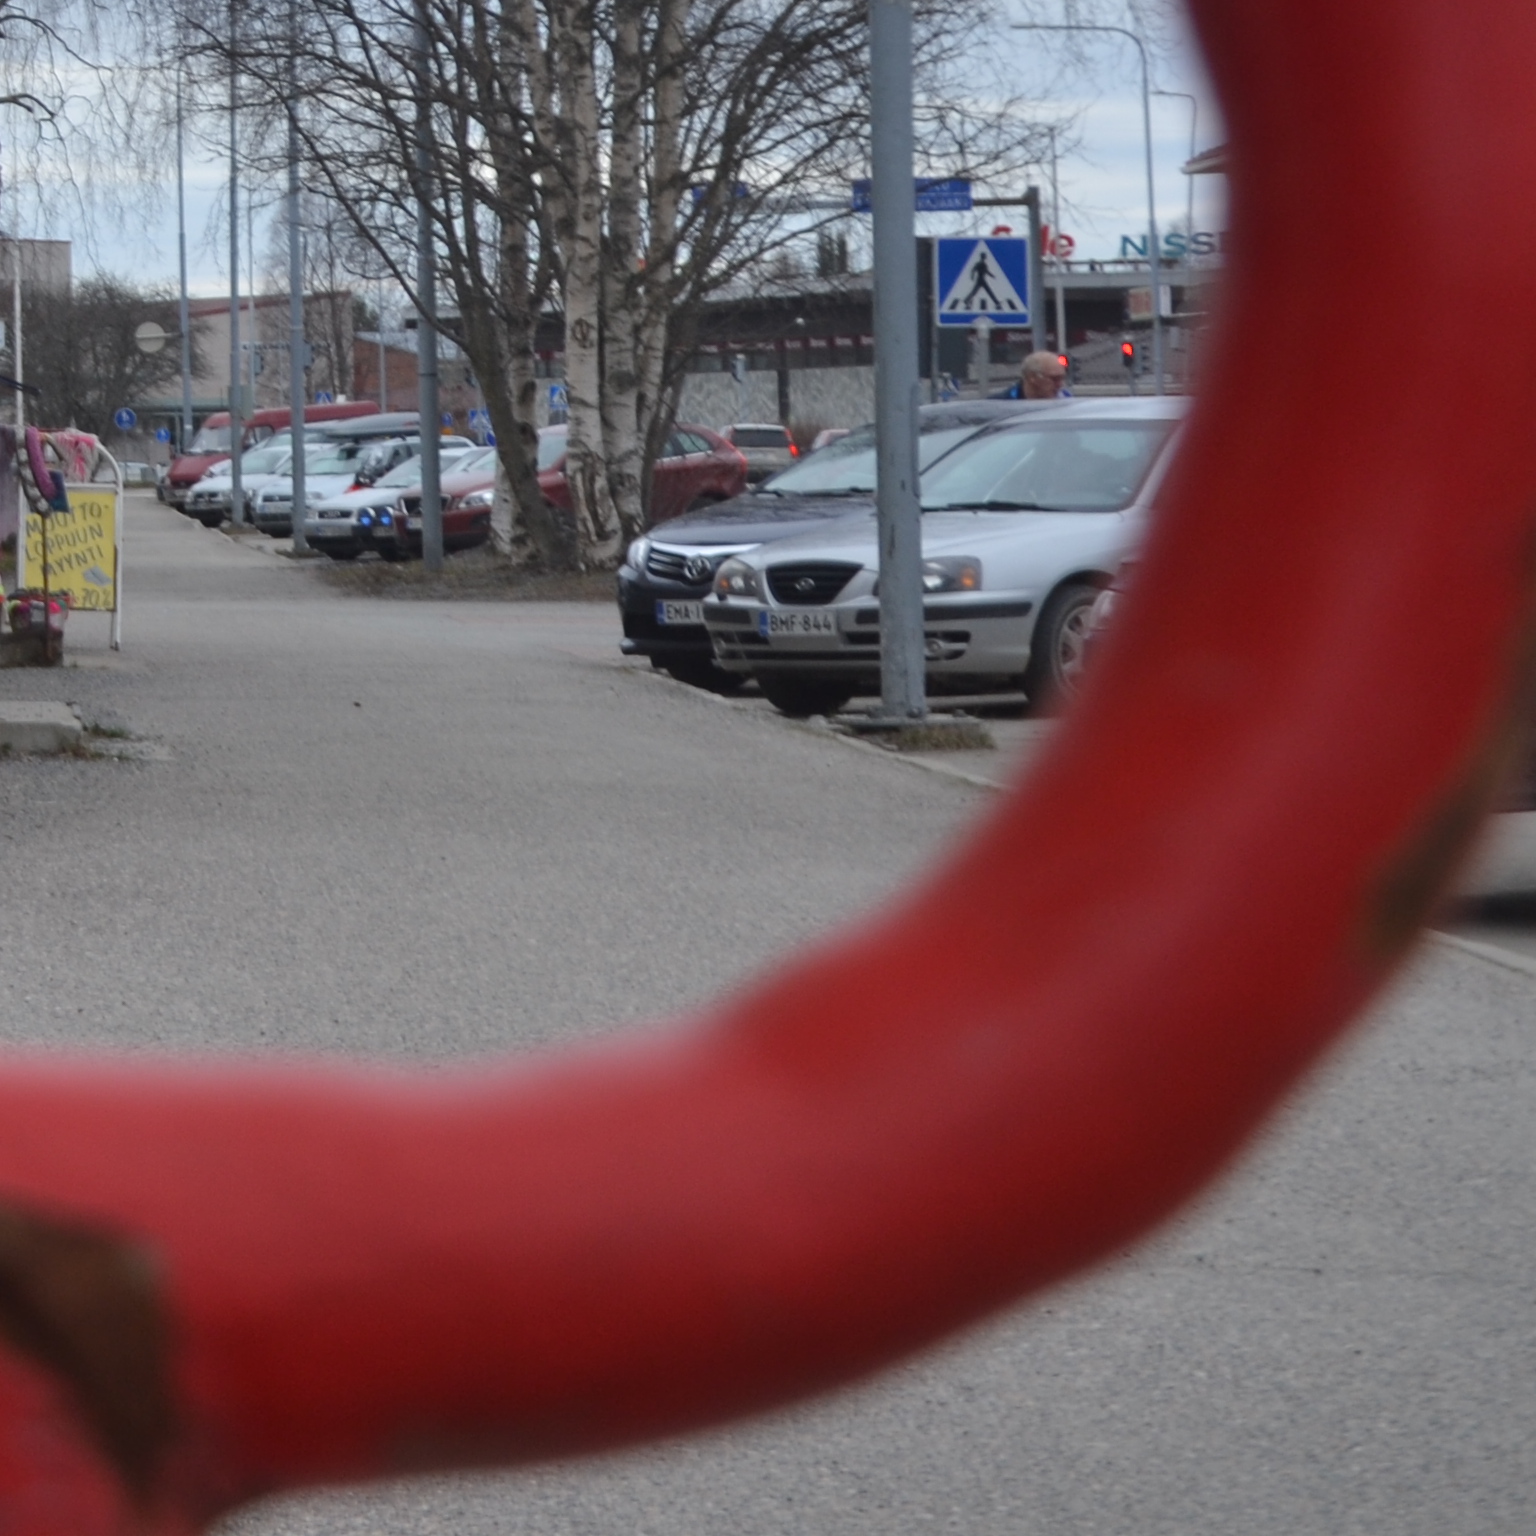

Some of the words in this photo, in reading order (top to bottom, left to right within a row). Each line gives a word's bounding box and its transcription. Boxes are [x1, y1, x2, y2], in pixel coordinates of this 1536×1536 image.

[991, 224, 1075, 257] le
[25, 522, 104, 562] LOPPUUN
[770, 615, 833, 631] BMF-844
